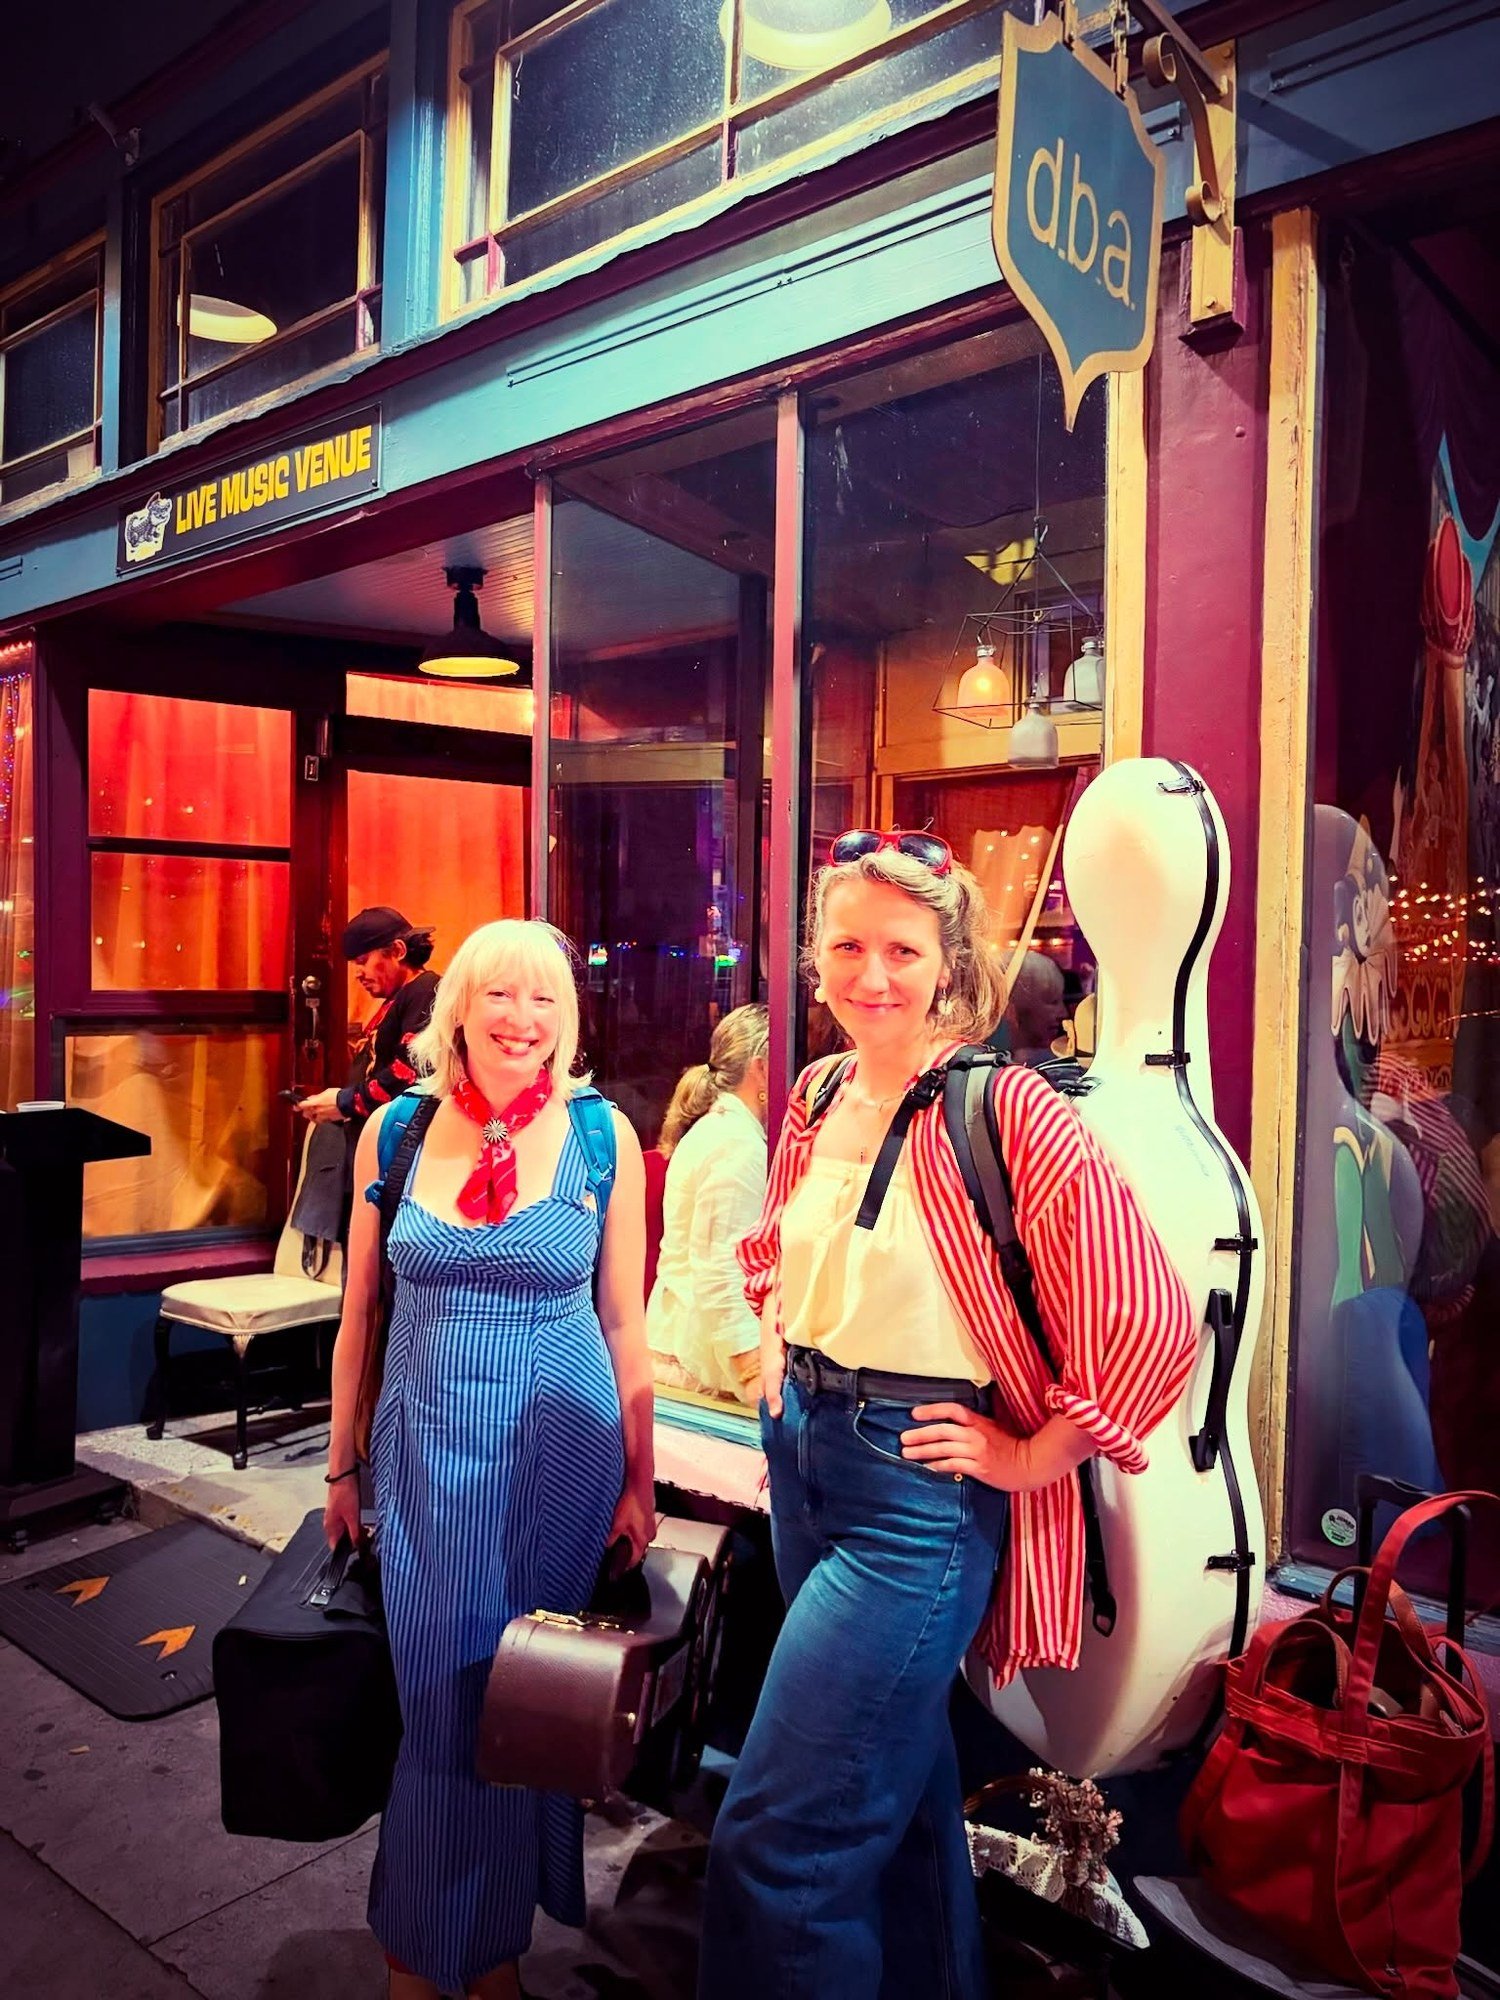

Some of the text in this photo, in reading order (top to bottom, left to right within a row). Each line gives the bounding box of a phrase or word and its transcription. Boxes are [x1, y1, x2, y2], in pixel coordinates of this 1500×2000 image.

[176, 425, 372, 534] LIVE MUSIC VENUE
